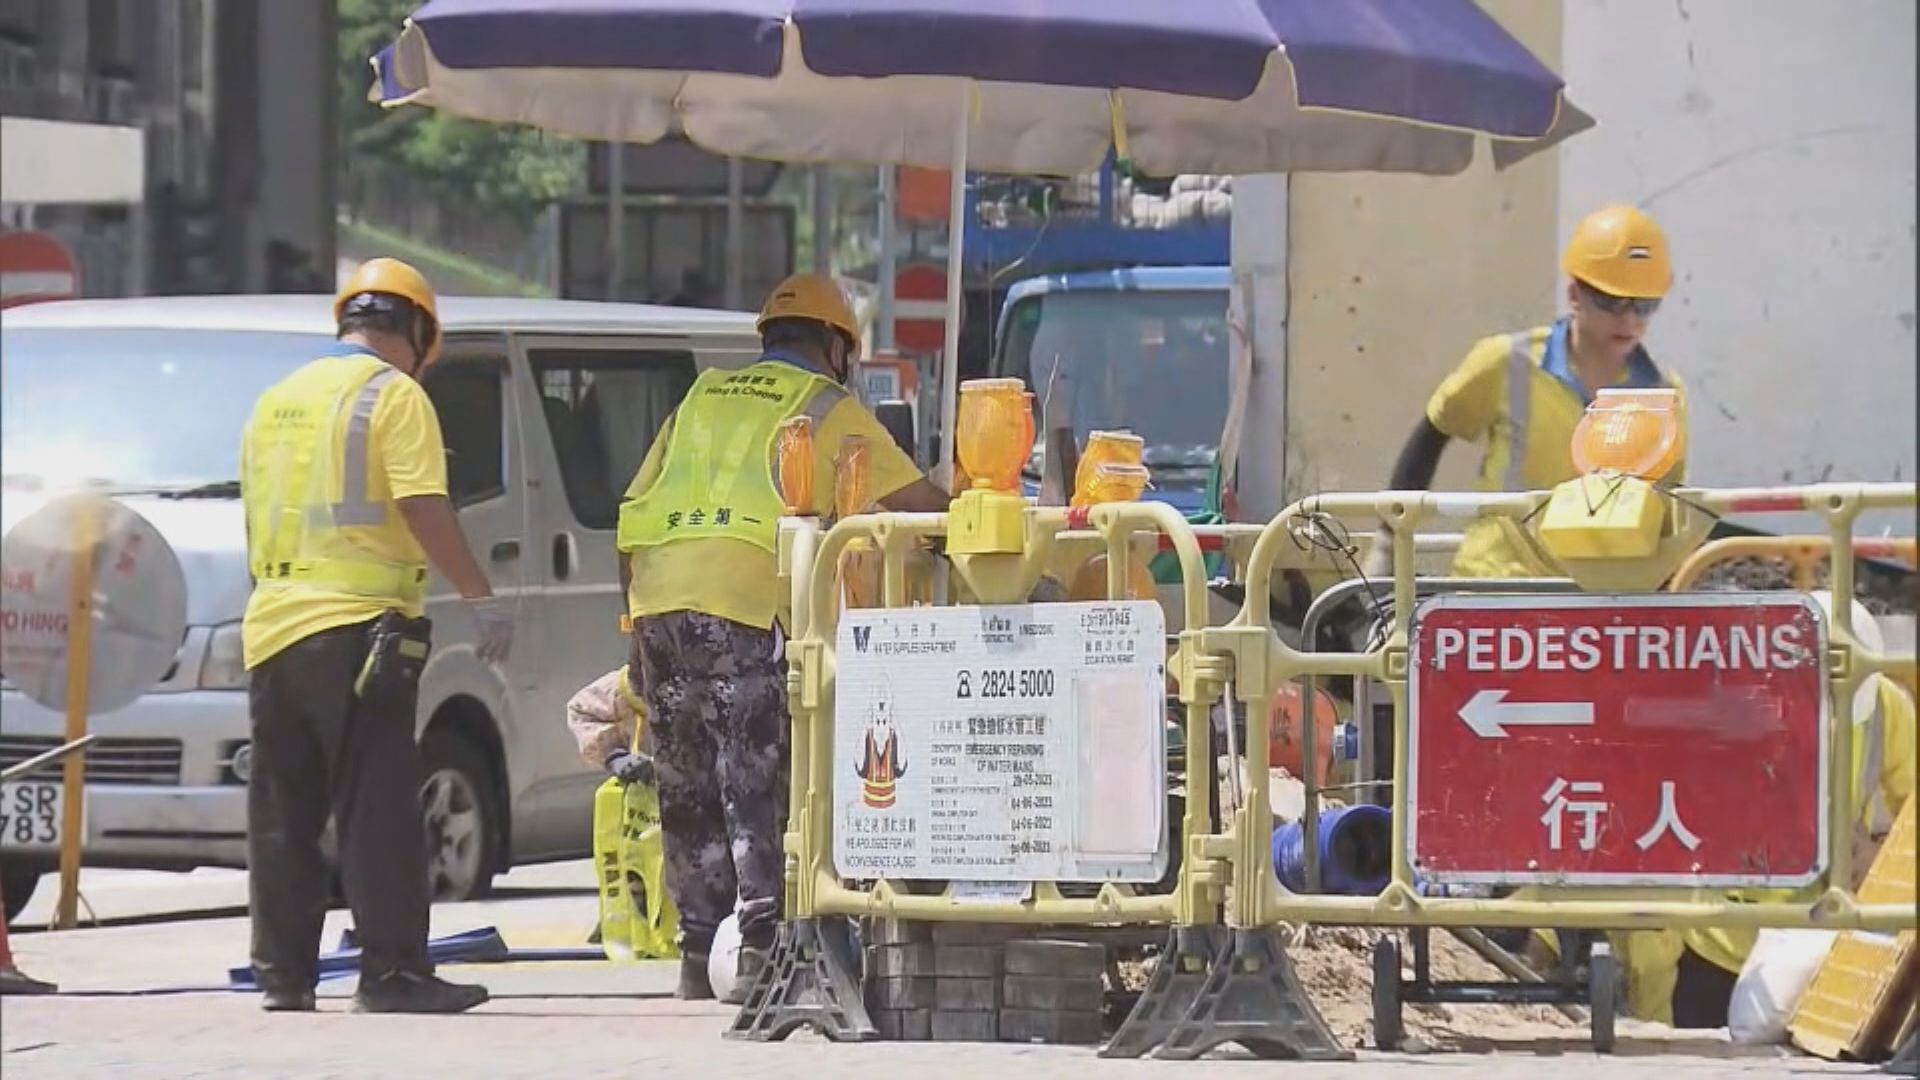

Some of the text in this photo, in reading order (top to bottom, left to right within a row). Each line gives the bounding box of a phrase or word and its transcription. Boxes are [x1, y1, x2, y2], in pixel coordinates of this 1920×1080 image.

[667, 507, 762, 531] 安全第一
[1435, 624, 1802, 672] PEDESTRIANS
[981, 669, 1054, 698] 2824 5000
[1539, 776, 1702, 852] 行人
